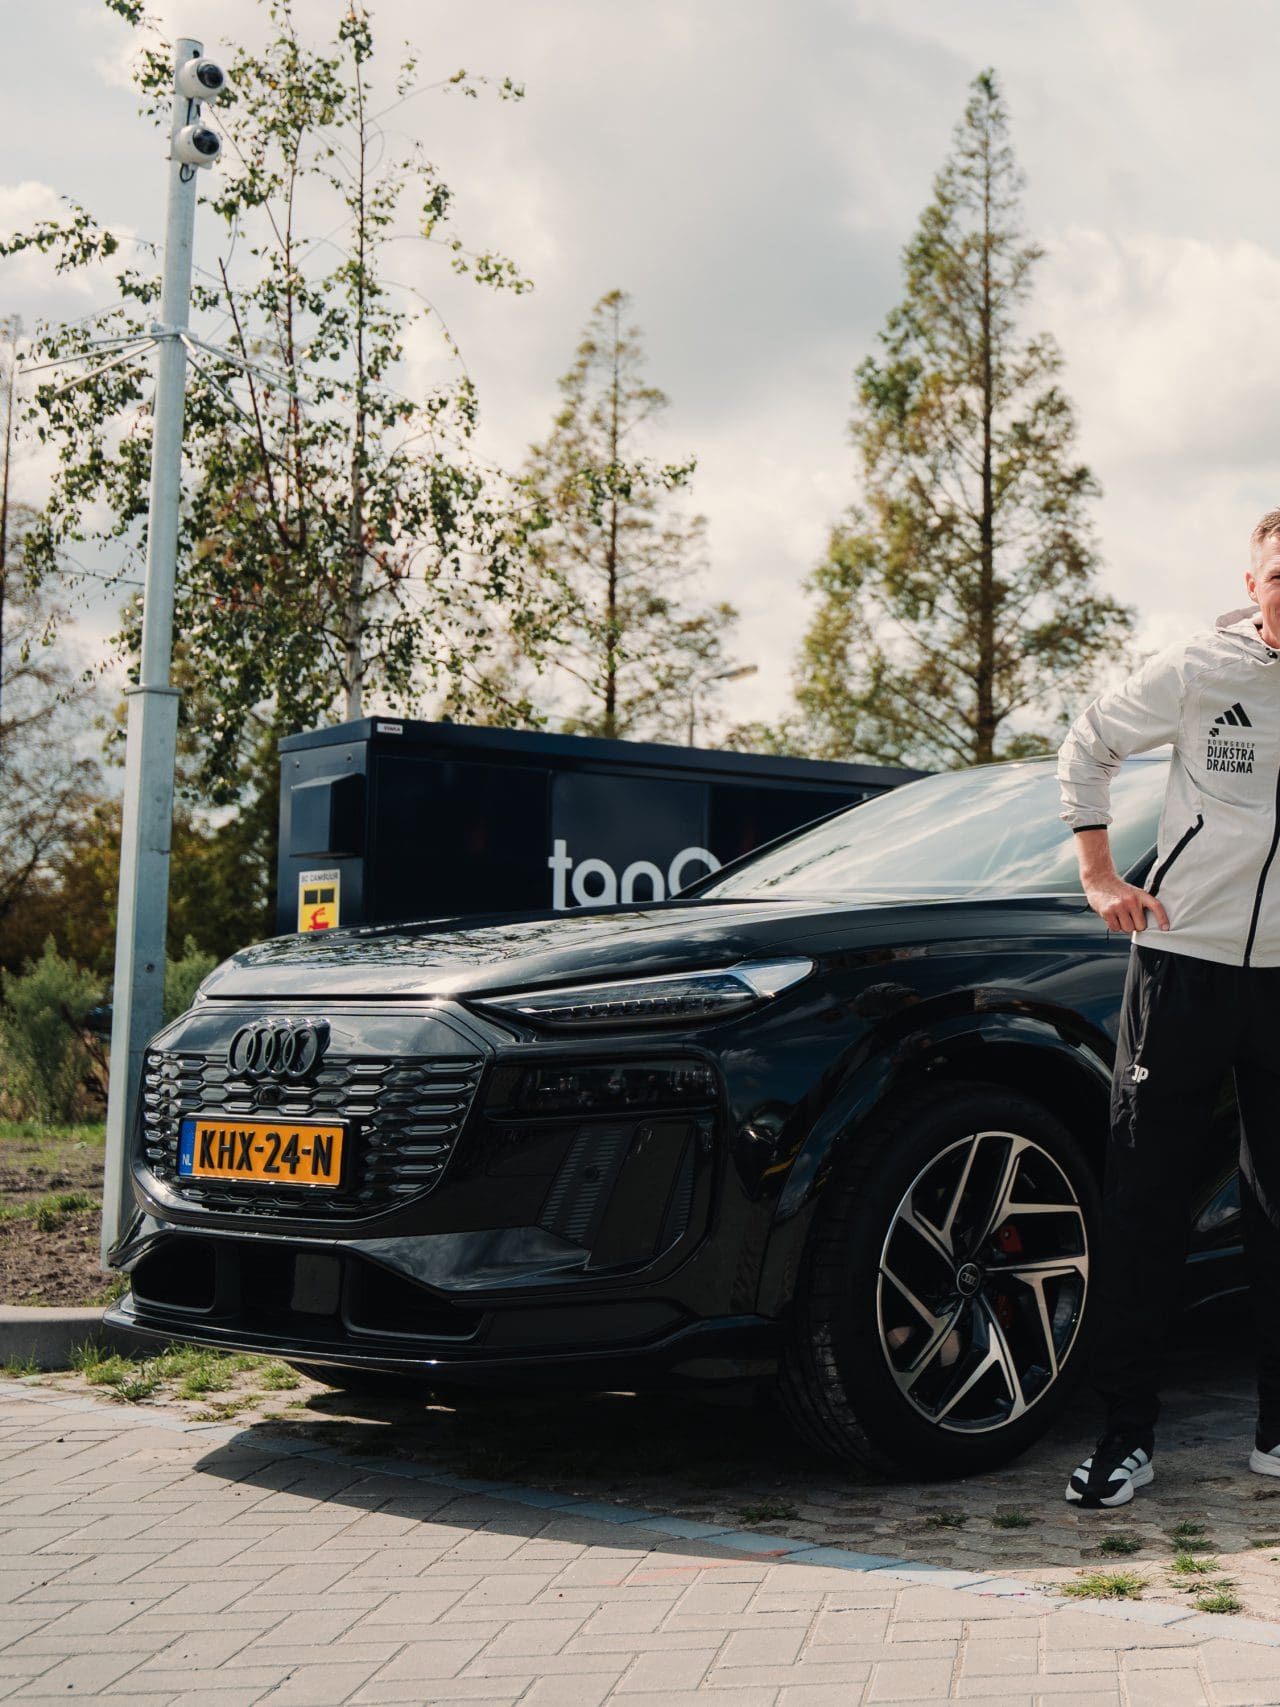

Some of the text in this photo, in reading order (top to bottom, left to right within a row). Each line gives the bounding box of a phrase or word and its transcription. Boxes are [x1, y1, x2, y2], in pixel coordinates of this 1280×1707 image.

[1207, 739, 1255, 749] BOUWGROEP
[1207, 745, 1255, 761] DIJKSTRA
[1206, 758, 1253, 774] DRAISMA
[1131, 1064, 1149, 1083] JP
[182, 1129, 334, 1176] NL KHX-24-N
